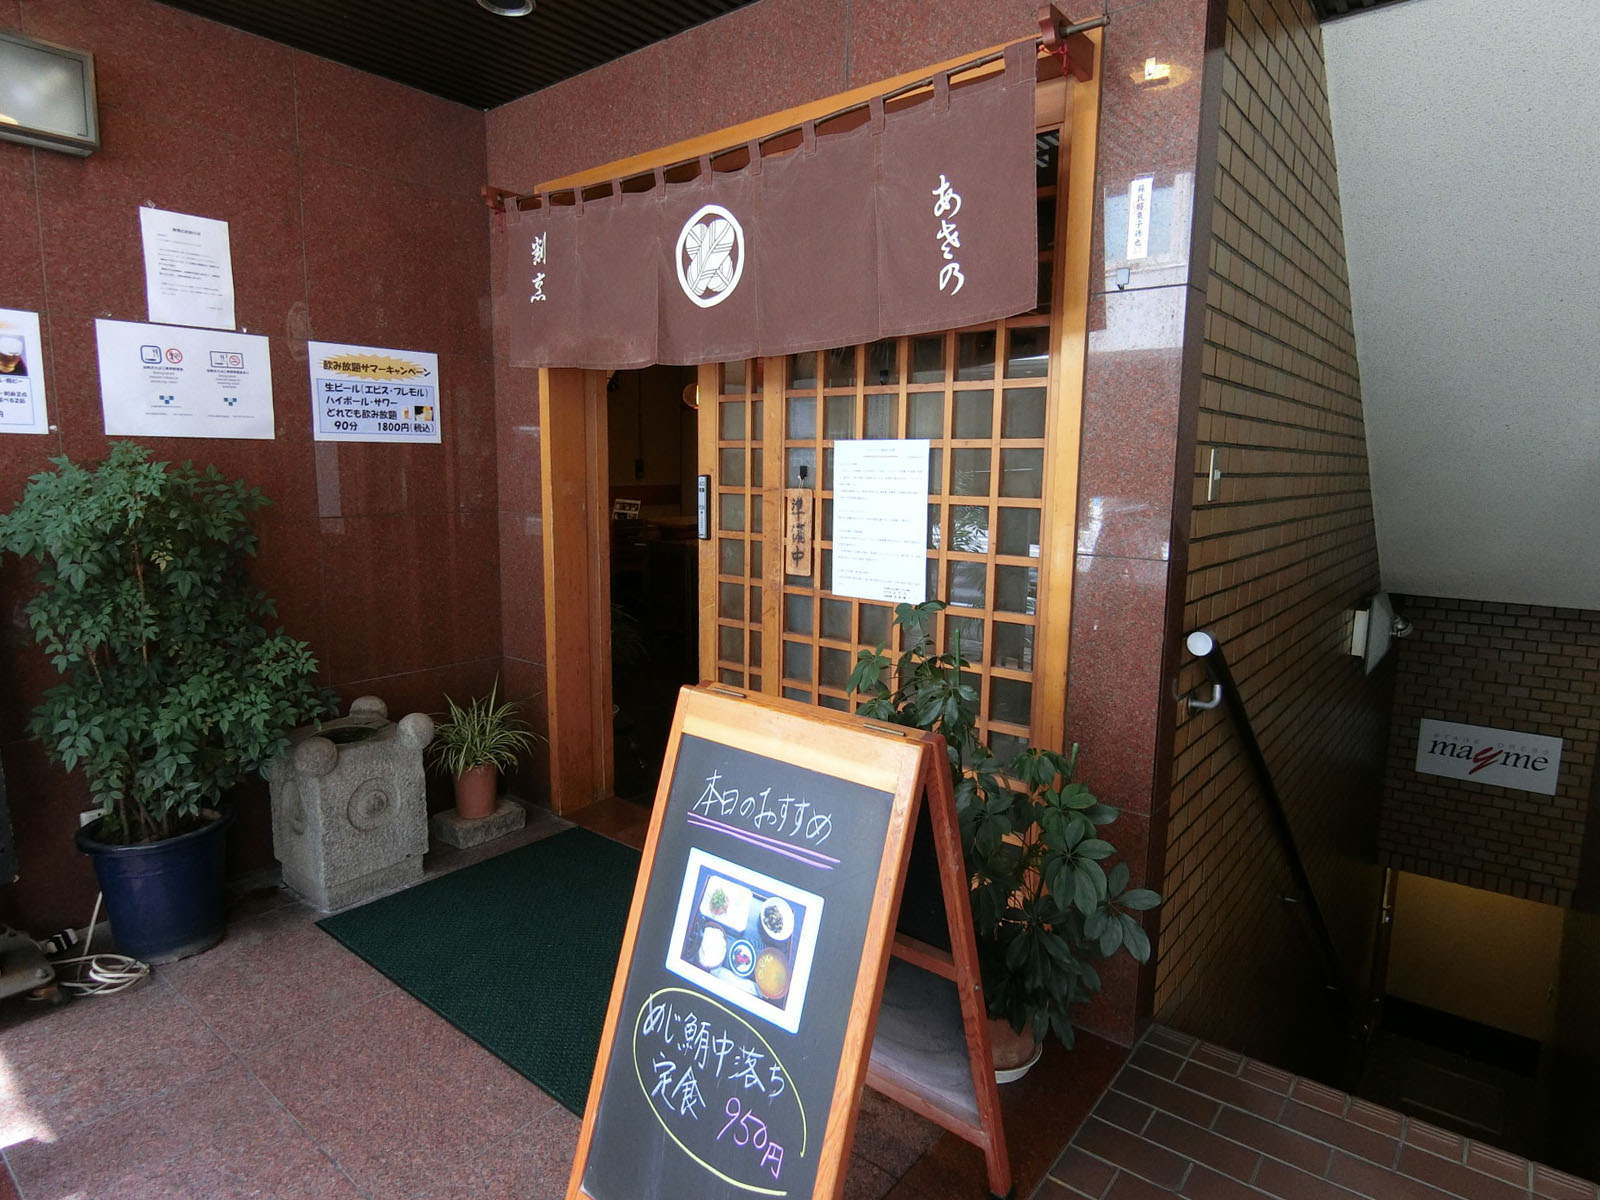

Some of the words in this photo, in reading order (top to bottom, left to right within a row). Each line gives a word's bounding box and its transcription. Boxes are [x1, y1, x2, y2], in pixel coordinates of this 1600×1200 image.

[323, 360, 431, 377] 飲み放題サマーキャンペーン
[326, 396, 398, 407] ハイボール・サワー
[326, 408, 398, 420] どれでも飲み放題
[334, 421, 358, 431] 90分
[377, 422, 434, 433] 1800円（税込）
[791, 497, 805, 568] 準備中
[1428, 739, 1549, 775] mayme
[692, 769, 833, 846] 本日のおすすめ
[650, 1051, 706, 1120] 定食
[716, 1097, 784, 1179] 950円
